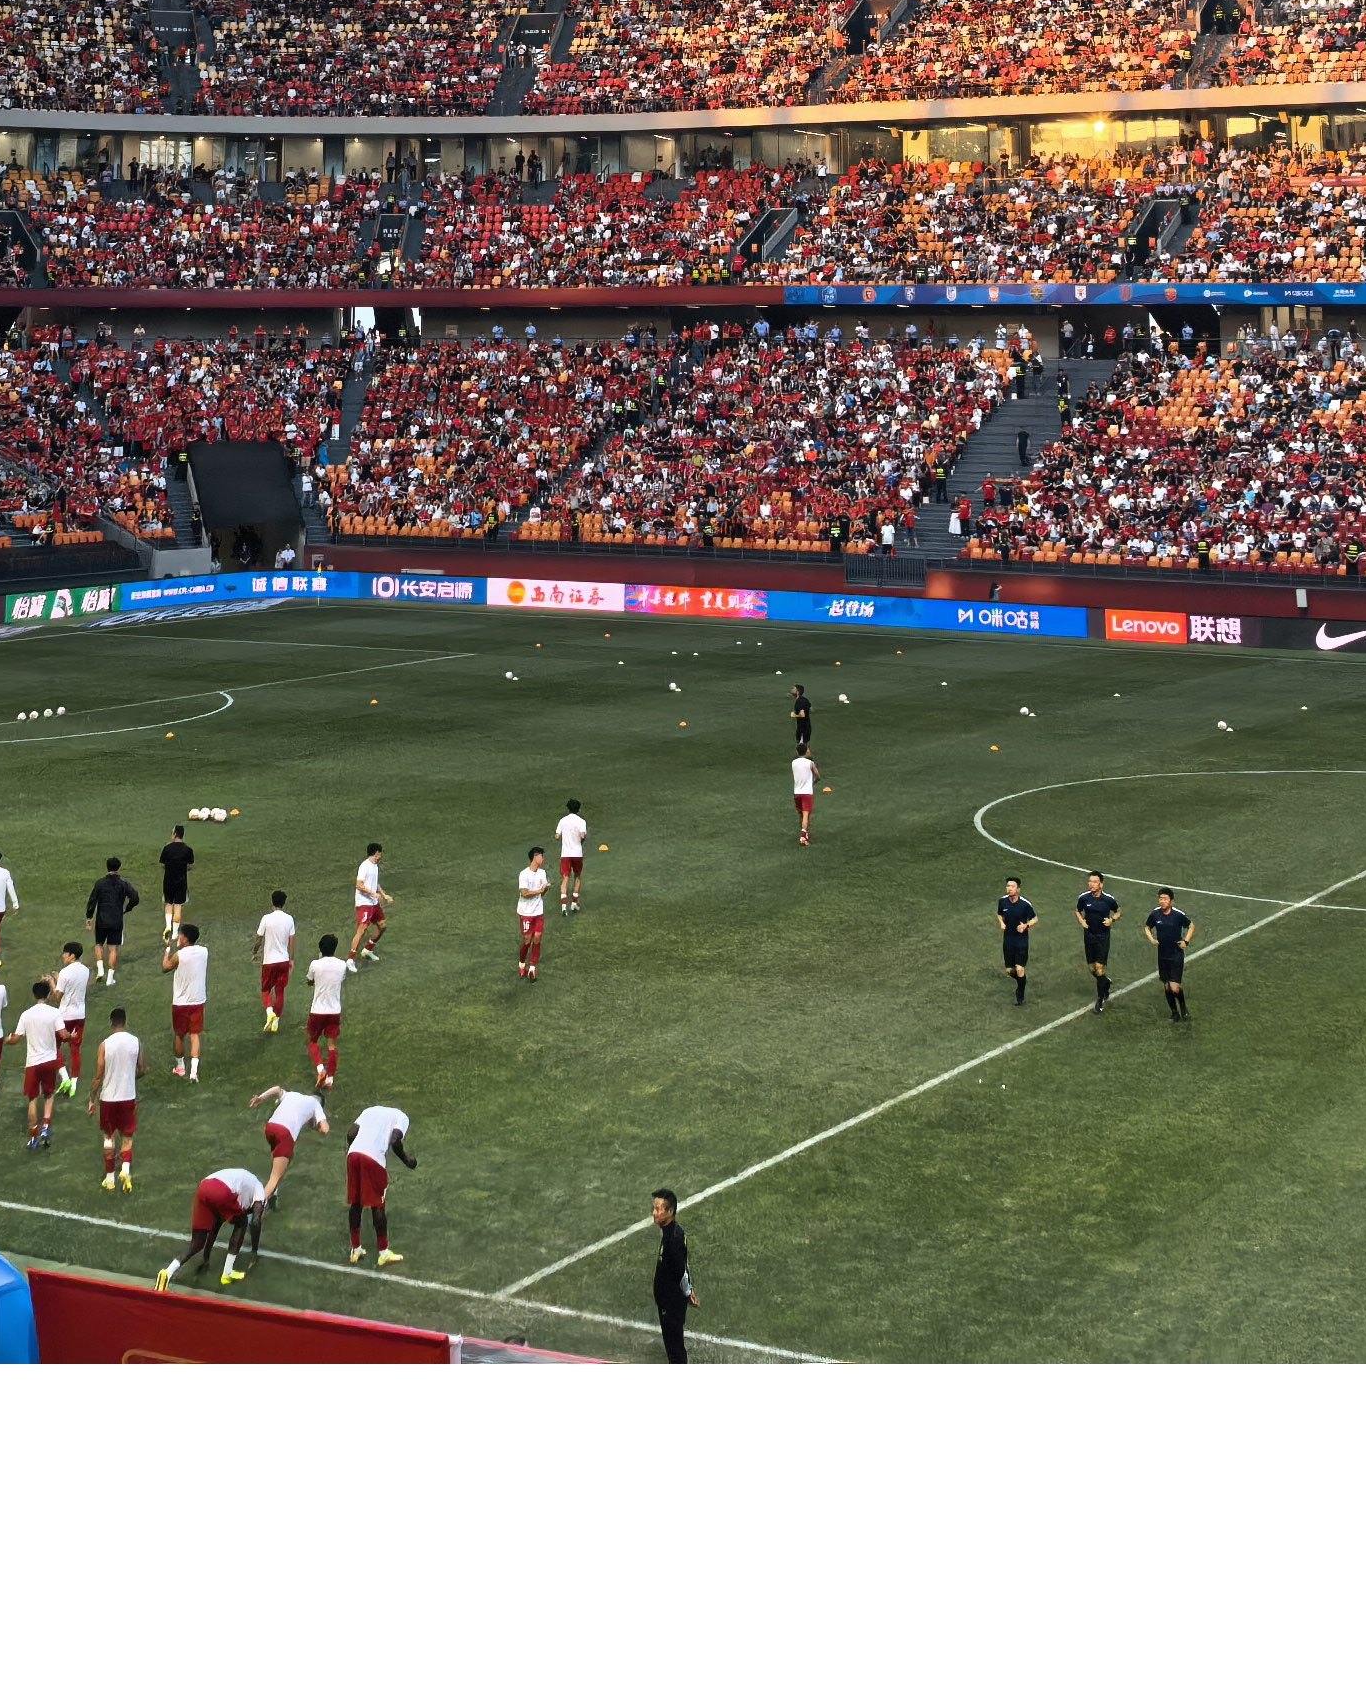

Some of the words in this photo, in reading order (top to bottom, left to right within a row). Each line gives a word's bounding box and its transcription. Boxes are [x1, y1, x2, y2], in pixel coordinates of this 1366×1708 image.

[253, 577, 326, 591] 诚信联赛
[402, 580, 472, 599] 长安启源
[1113, 617, 1179, 634] Lenovo
[1190, 616, 1241, 643] 联想
